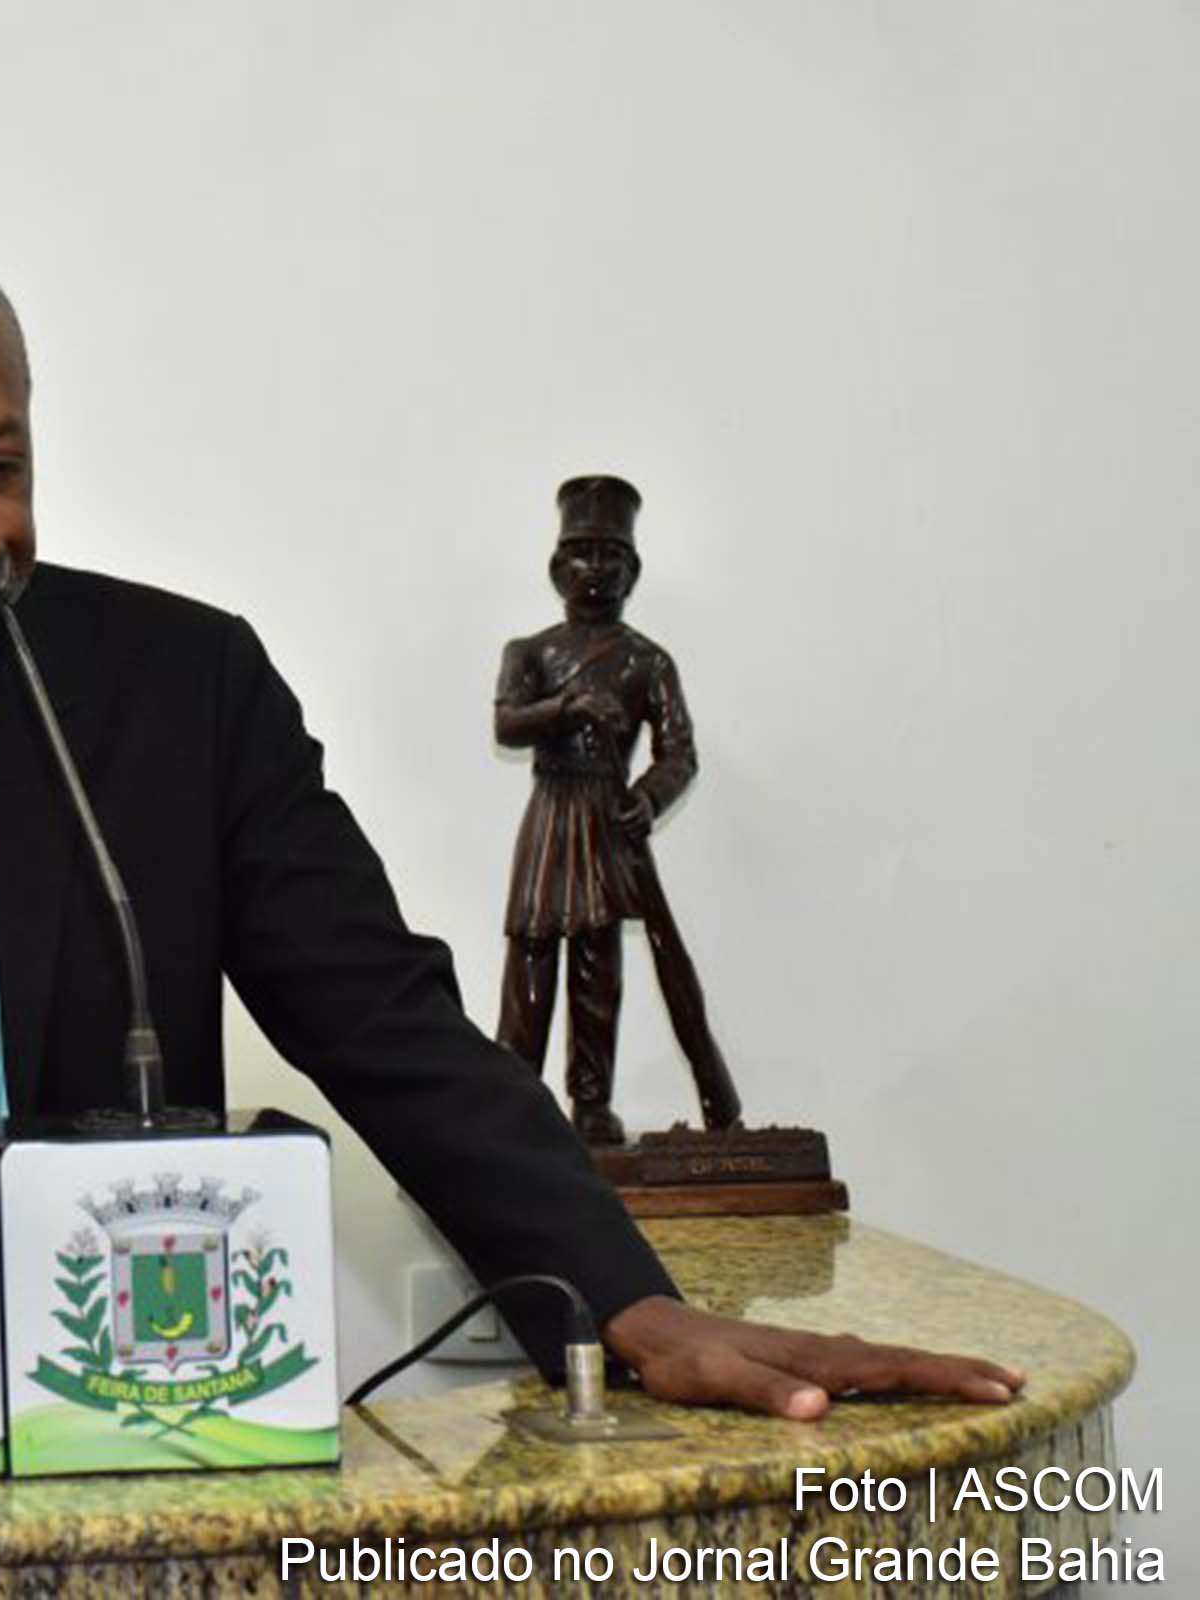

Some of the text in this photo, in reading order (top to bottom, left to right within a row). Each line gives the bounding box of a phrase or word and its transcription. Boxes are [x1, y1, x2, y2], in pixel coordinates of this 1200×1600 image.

[86, 1367, 257, 1403] FEIRA DE SANTANA
